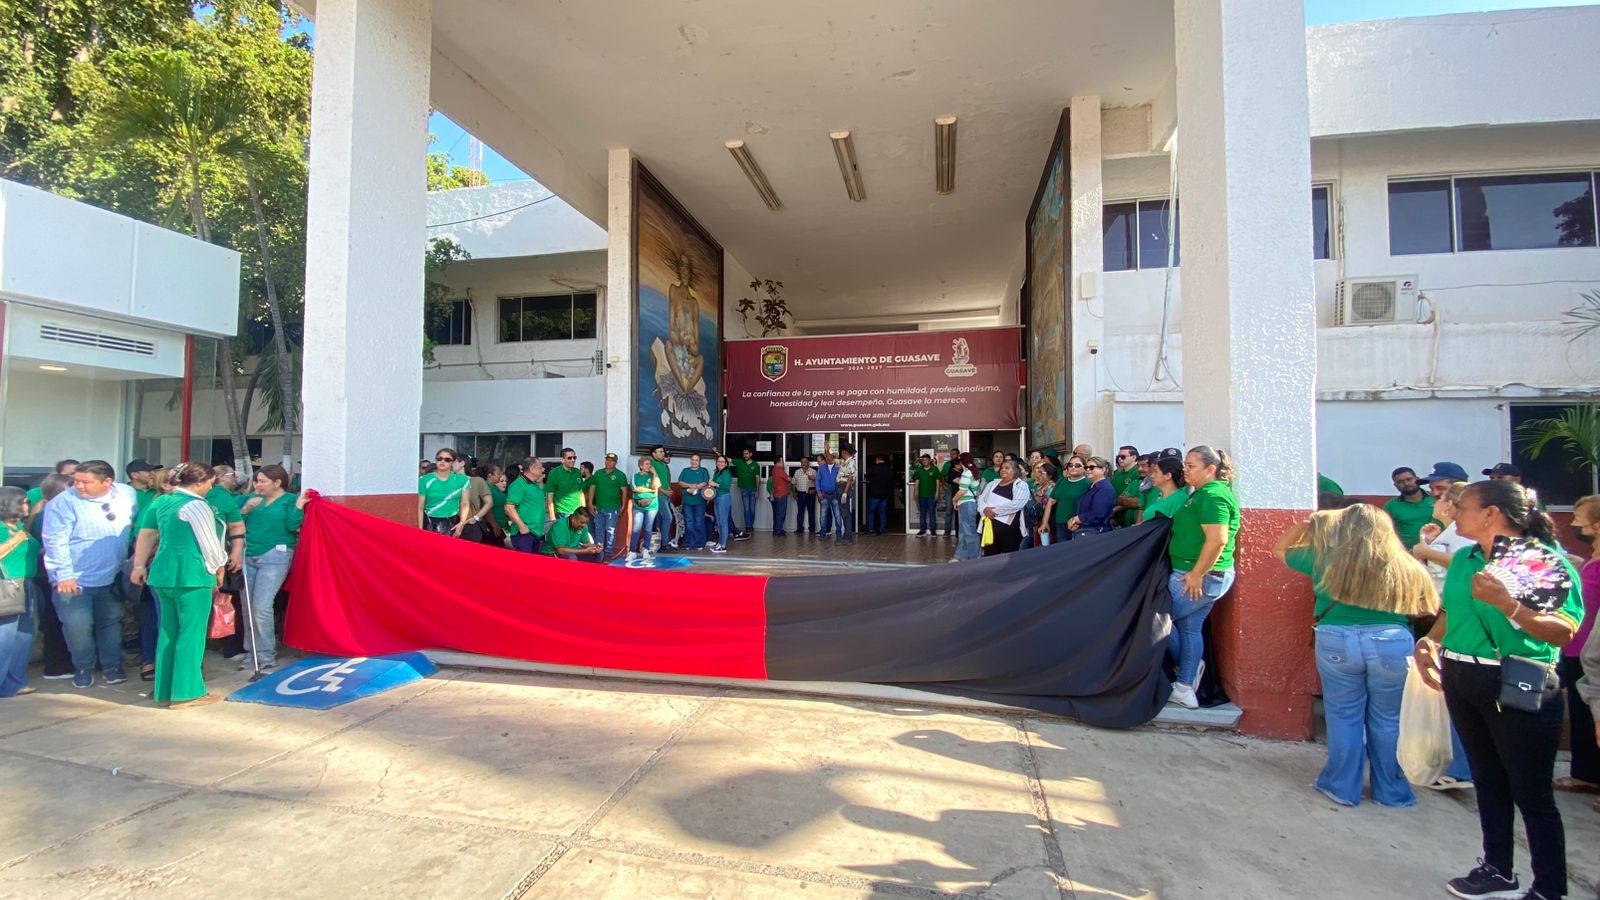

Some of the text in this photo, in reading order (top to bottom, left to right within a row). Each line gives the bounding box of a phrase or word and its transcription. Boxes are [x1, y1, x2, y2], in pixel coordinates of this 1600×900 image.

[805, 356, 878, 366] AYUNTAMIENTO
[894, 354, 940, 363] GUASAVE
[752, 390, 790, 398] confianza
[812, 390, 835, 398] gente
[846, 389, 868, 397] paga
[929, 385, 1001, 395] profesionalismo,
[836, 398, 885, 406] desempeño,
[886, 397, 923, 405] Guasave
[806, 412, 827, 420] ¡Aquí
[900, 411, 929, 419] pueblo!
